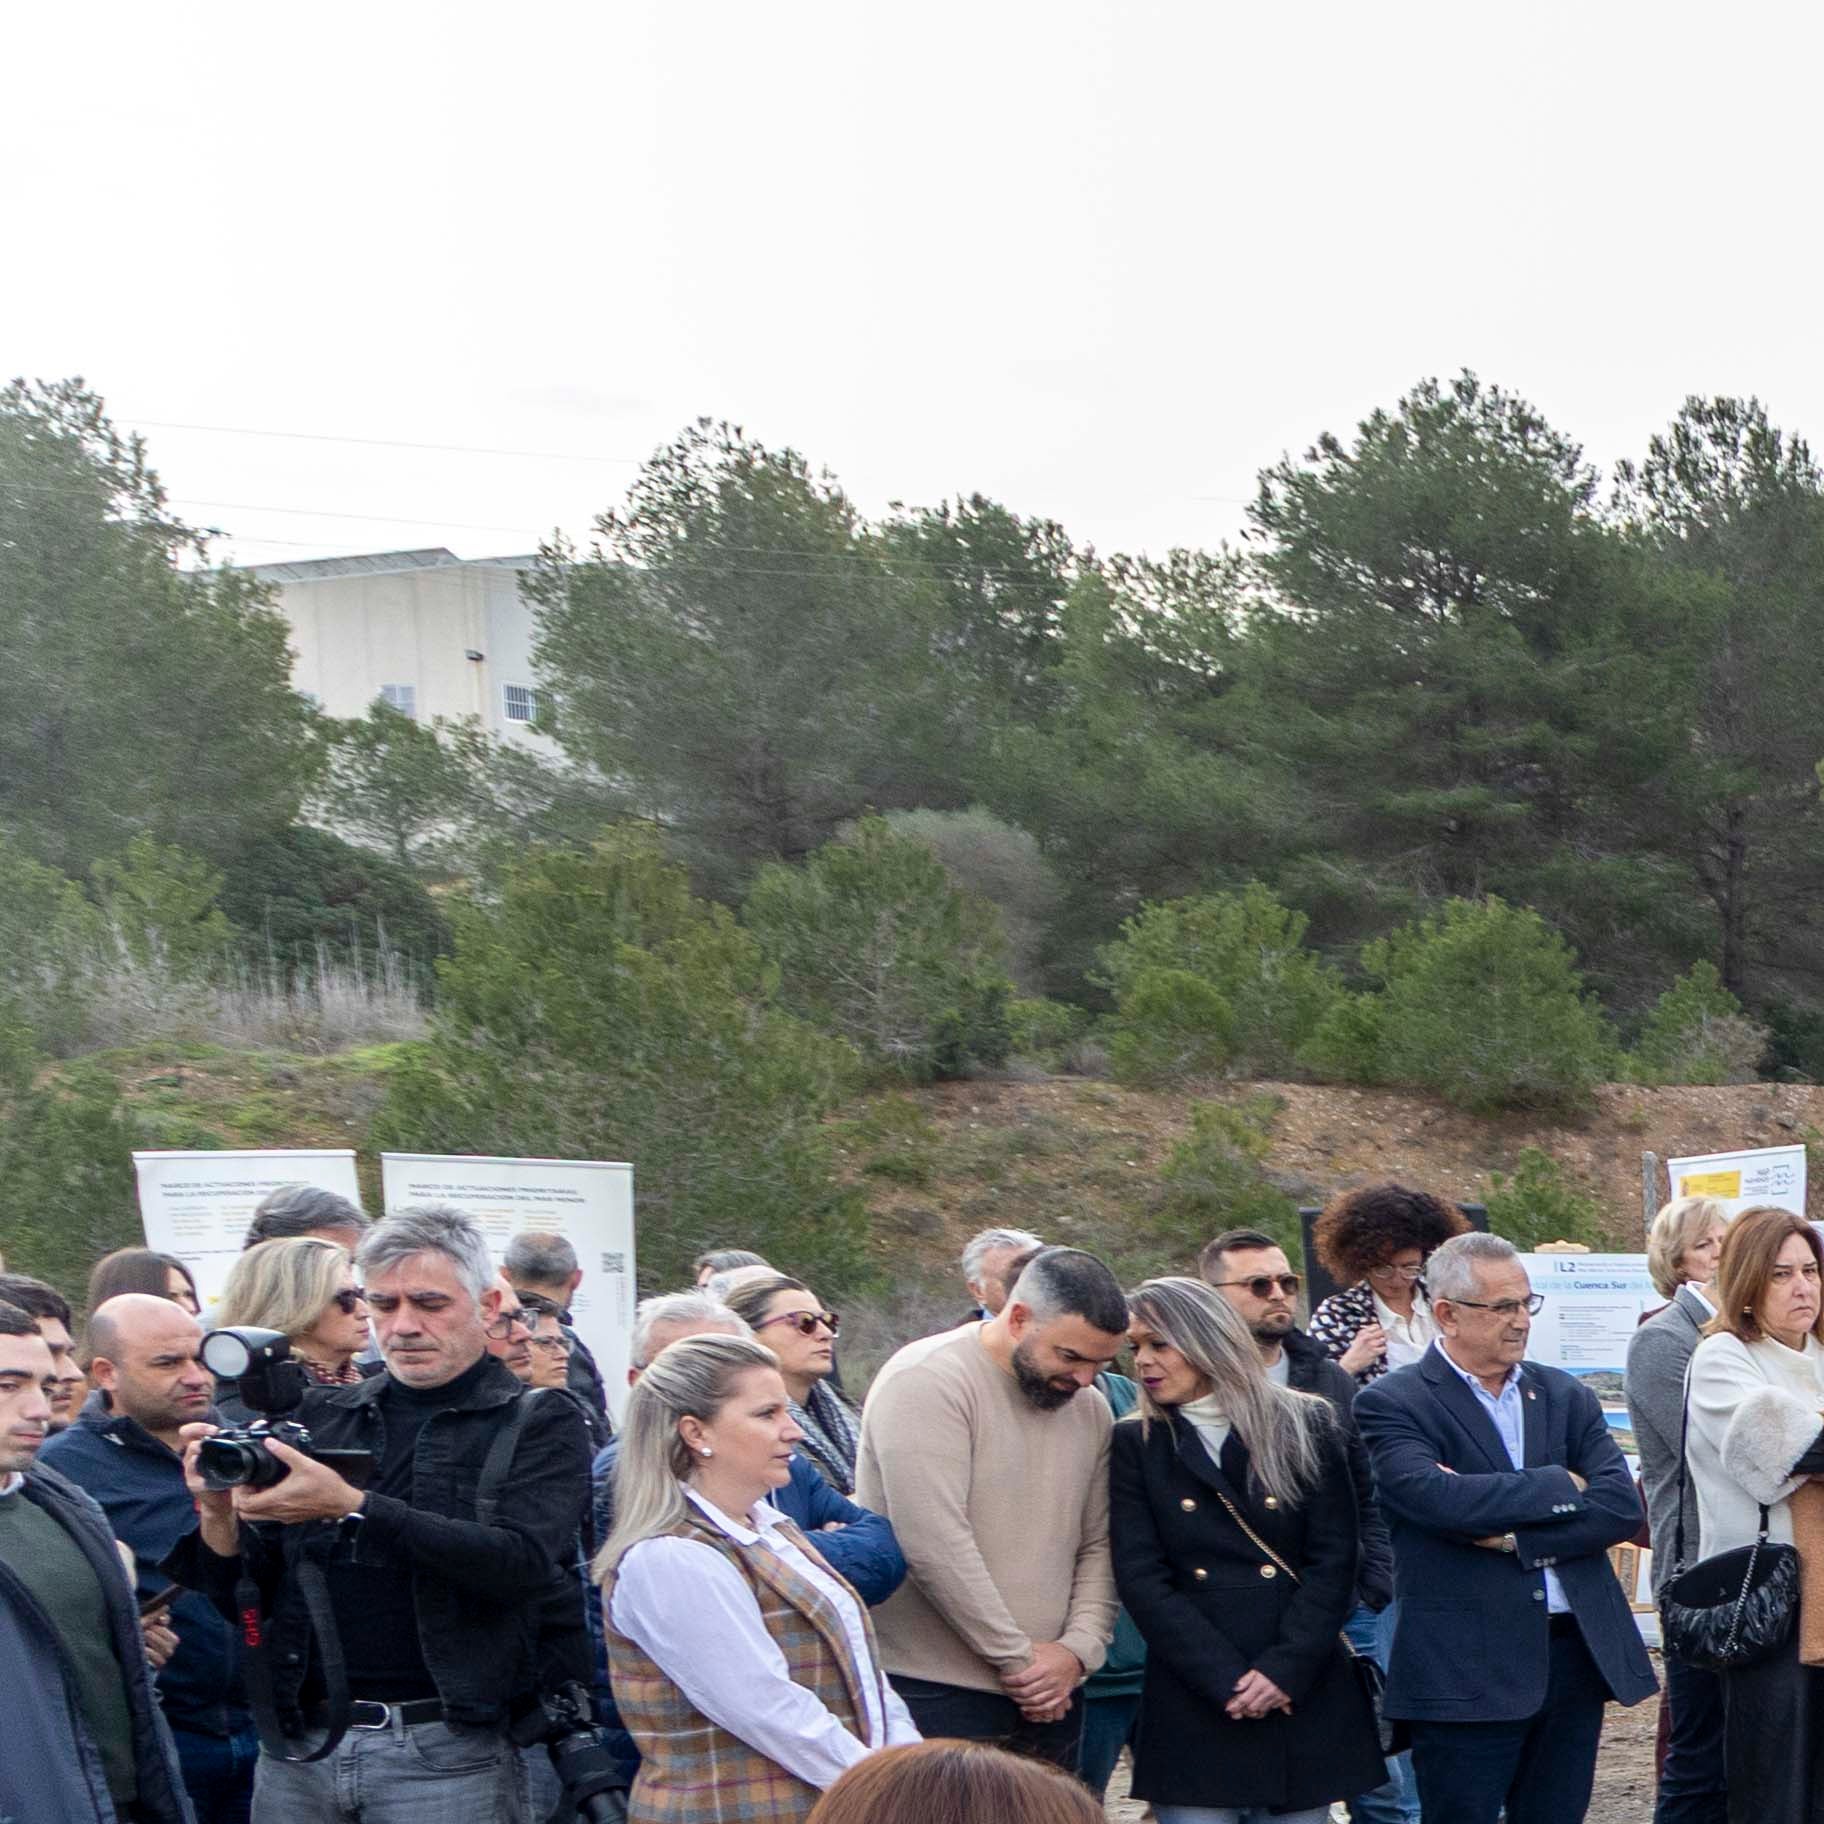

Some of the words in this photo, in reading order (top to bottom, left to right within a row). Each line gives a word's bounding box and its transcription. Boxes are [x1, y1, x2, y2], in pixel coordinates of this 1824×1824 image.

[1559, 1261, 1577, 1273] L2
[1573, 1281, 1609, 1290] Cuenca
[1611, 1281, 1627, 1289] Sur
